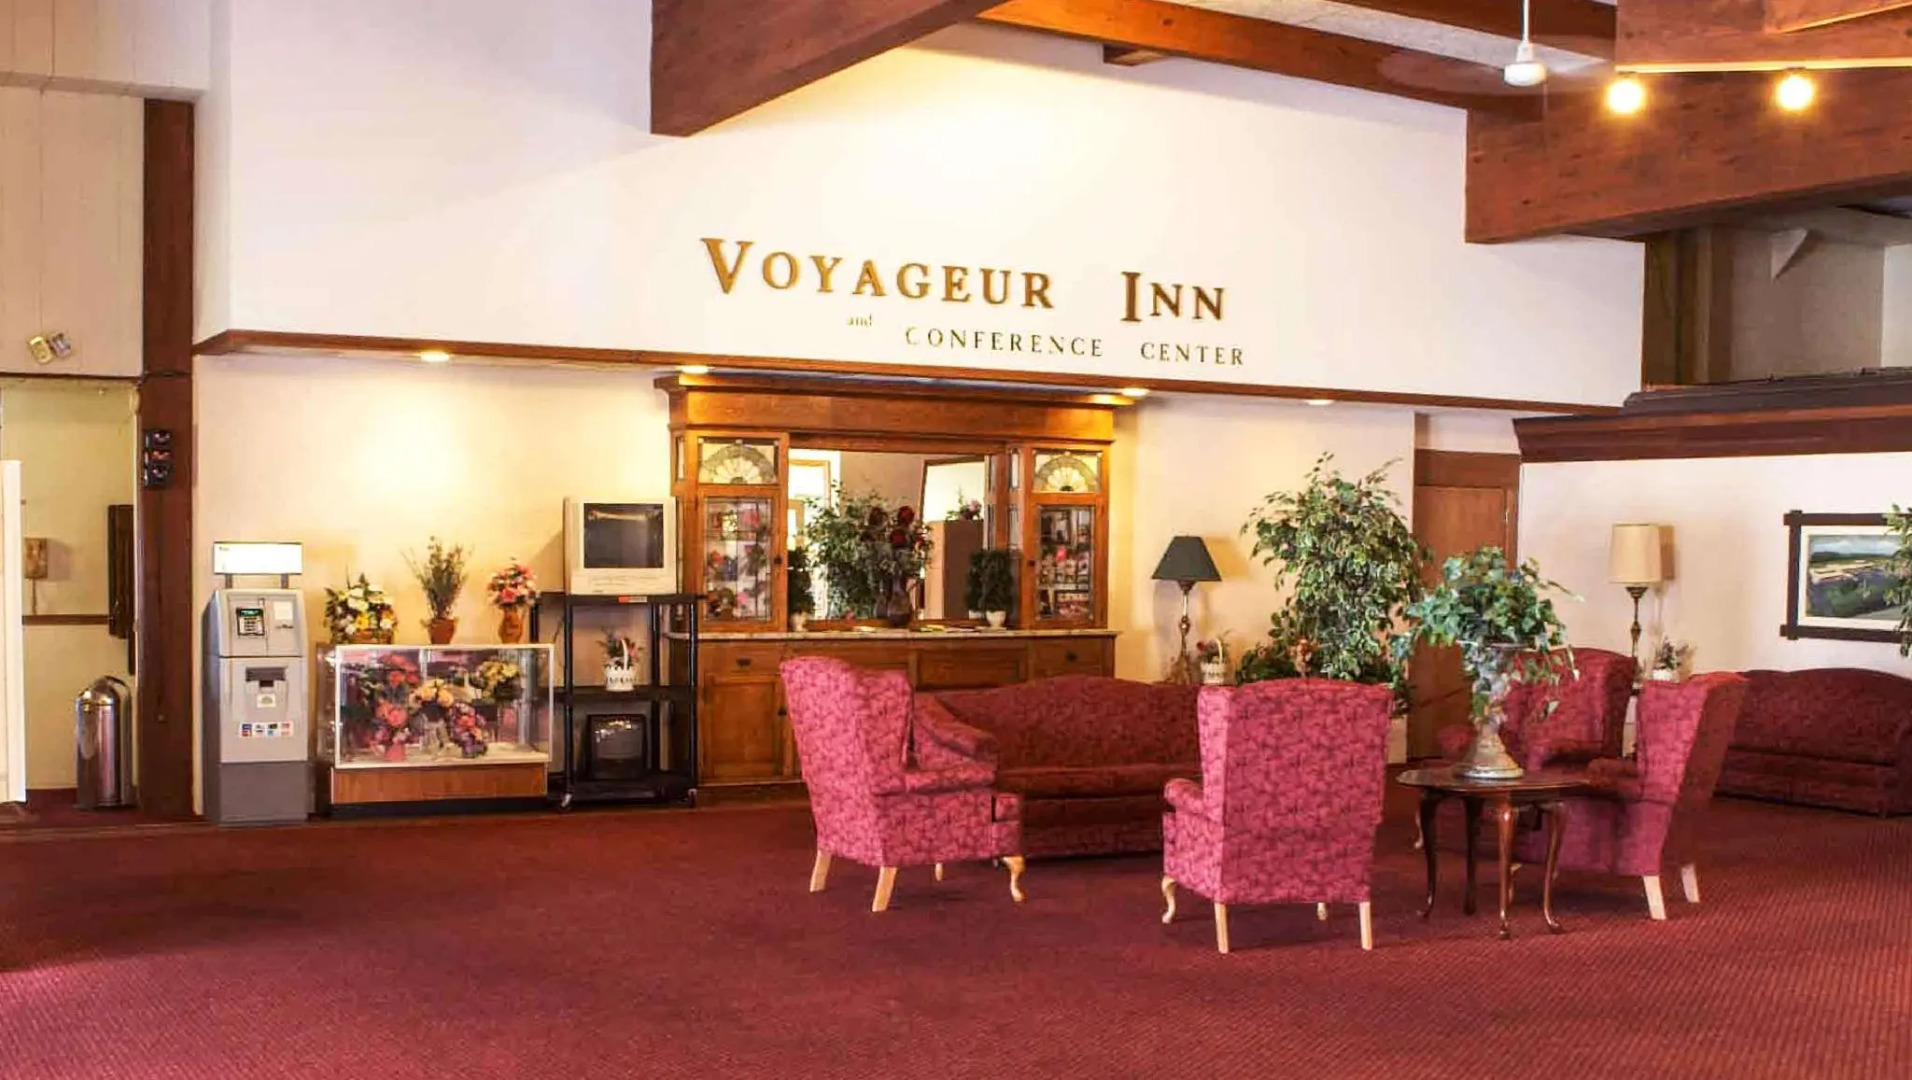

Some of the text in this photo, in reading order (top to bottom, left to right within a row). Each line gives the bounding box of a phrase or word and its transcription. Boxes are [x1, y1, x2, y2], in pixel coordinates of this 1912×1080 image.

[700, 237, 1225, 323] VOYAGEUR INN
[847, 314, 1244, 365] and CONFERENCE CENTER
